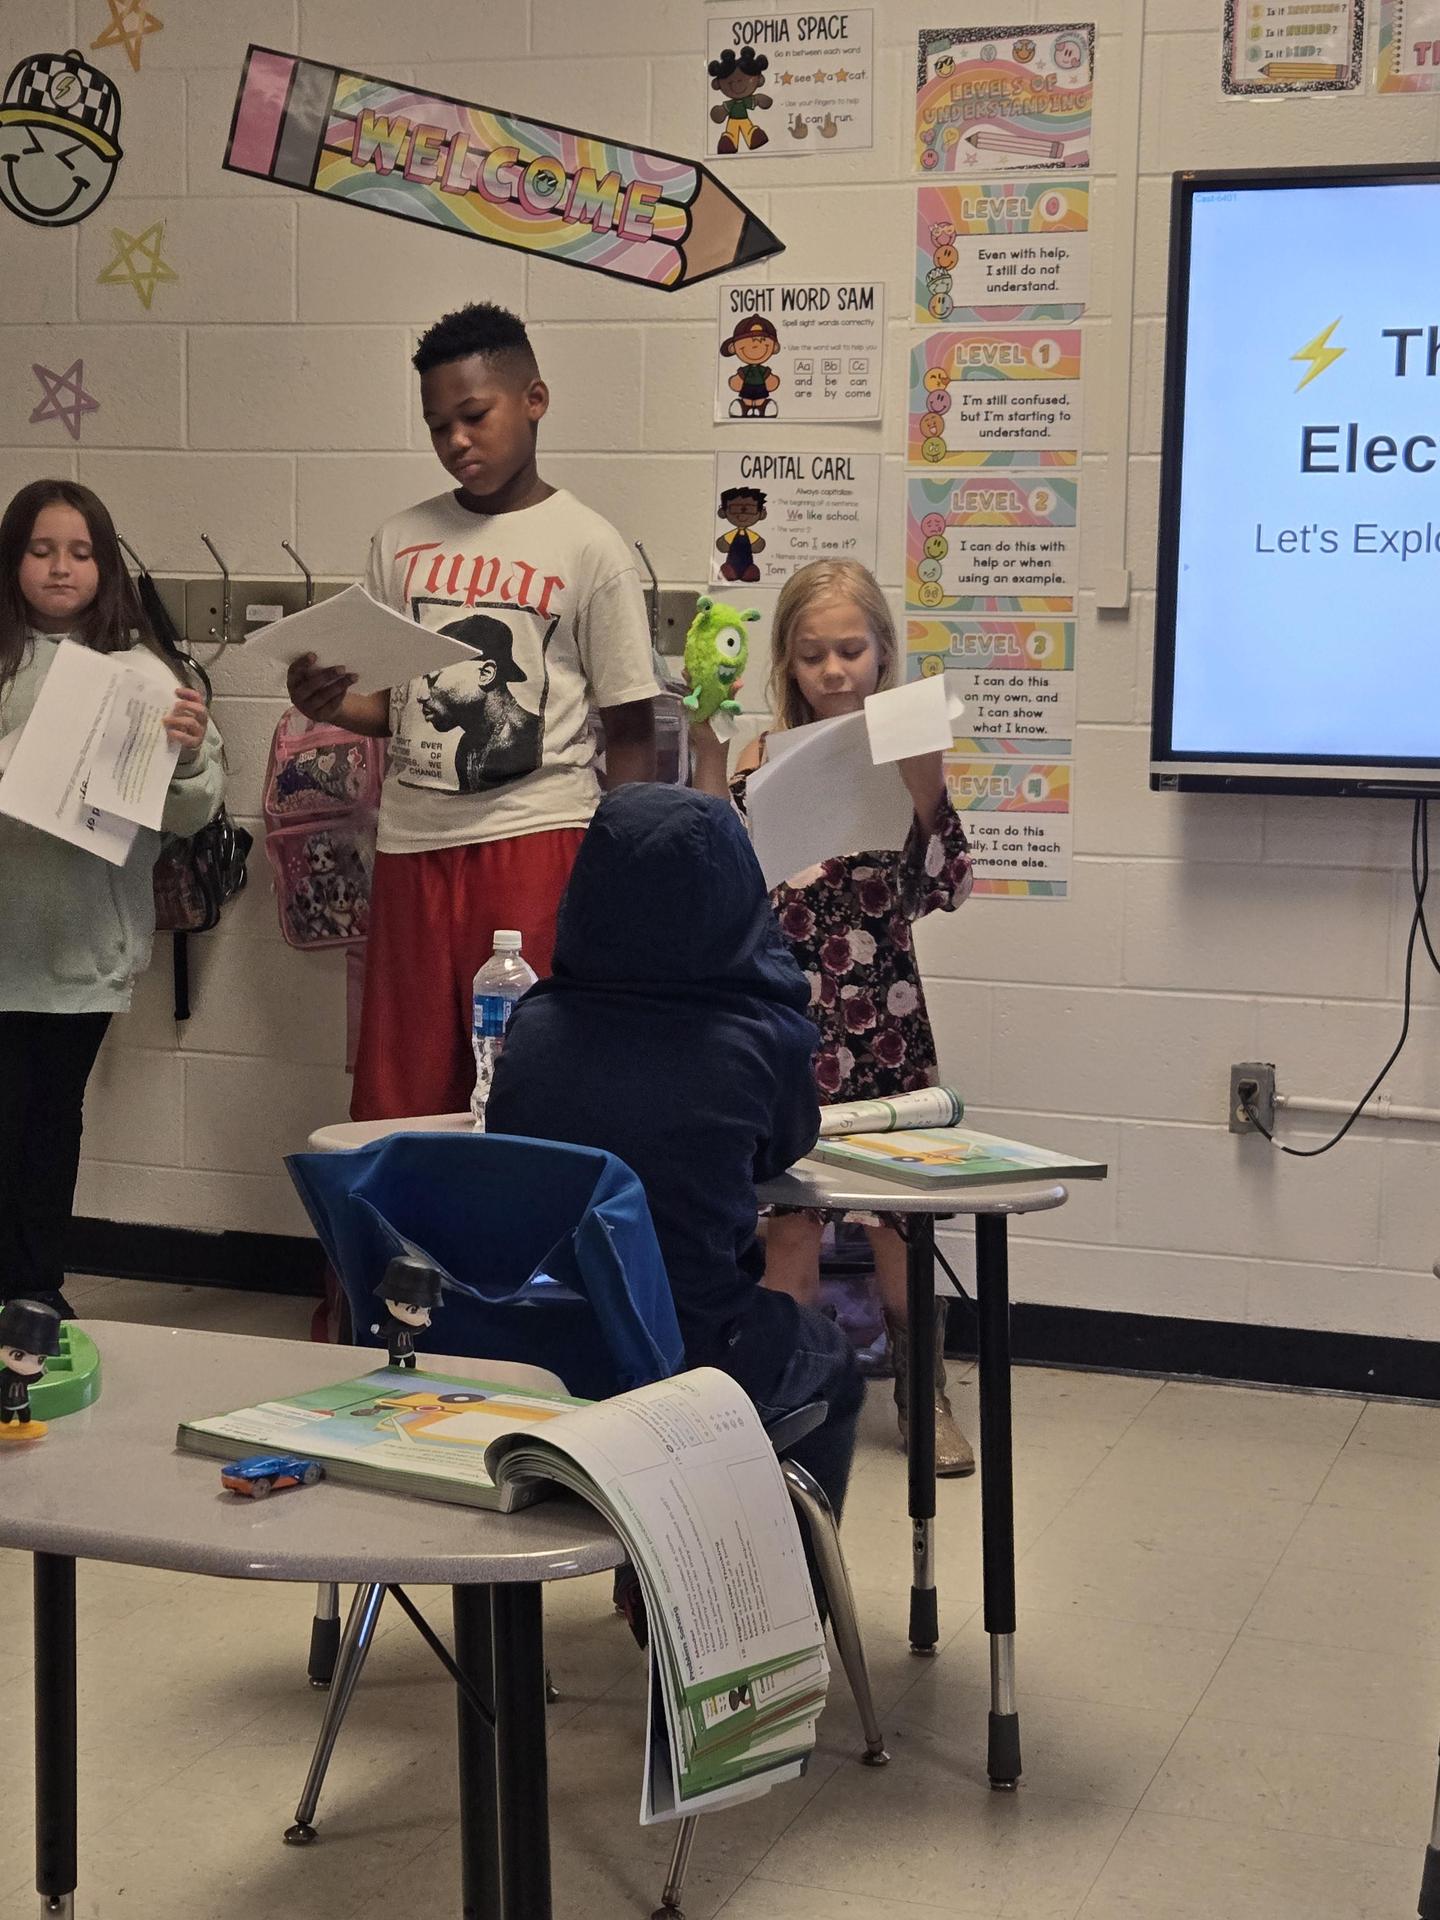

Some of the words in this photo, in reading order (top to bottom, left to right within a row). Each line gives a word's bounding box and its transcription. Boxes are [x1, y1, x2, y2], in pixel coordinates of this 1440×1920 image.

[732, 18, 789, 46] SOPHIA
[797, 15, 848, 41] SPACE
[792, 49, 822, 57] between
[774, 73, 780, 84] I
[794, 74, 811, 83] see
[826, 73, 833, 81] a
[951, 78, 1024, 102] LEVELS
[1031, 73, 1057, 92] OF
[922, 93, 1087, 124] UNDERSTANDING
[788, 114, 794, 124] I
[805, 115, 823, 124] can
[352, 109, 663, 243] WELCOME
[961, 197, 1033, 220] LEVEL
[1045, 197, 1059, 216] 0
[978, 249, 1006, 260] Even
[1010, 248, 1036, 259] with
[1040, 247, 1070, 260] help,
[986, 265, 992, 276] I
[996, 265, 1017, 275] still
[1021, 265, 1036, 275] do
[1040, 265, 1060, 274] not
[987, 280, 1059, 292] understand.
[730, 288, 775, 313] SIGHT
[781, 287, 830, 311] WORD
[837, 286, 874, 311] SAM
[782, 319, 798, 327] Spell
[799, 319, 815, 327] sight
[955, 343, 1025, 367] LEVEL
[1039, 344, 1050, 364] 1
[796, 361, 811, 371] Aa
[823, 361, 838, 371] Bb
[852, 361, 865, 371] Cc
[794, 376, 813, 386] and
[825, 376, 837, 386] be
[850, 378, 867, 386] can
[794, 390, 812, 398] are
[824, 388, 837, 399] by
[845, 390, 871, 398] come
[962, 395, 982, 405] I'm
[986, 395, 1007, 405] still
[1010, 394, 1070, 406] confused,
[960, 411, 980, 421] but
[984, 411, 1004, 421] I'm
[1008, 411, 1055, 423] starting
[1059, 411, 1071, 421] to
[979, 427, 1051, 438] understand.
[740, 455, 805, 480] CAPITAL
[811, 456, 855, 481] CARL
[796, 488, 819, 496] Always
[952, 490, 1023, 512] LEVEL
[1034, 491, 1049, 512] 2
[787, 510, 803, 521] We
[806, 510, 822, 520] like
[826, 510, 860, 521] school.
[790, 537, 808, 548] Can
[812, 537, 818, 550] I
[821, 541, 839, 549] see
[842, 538, 856, 549] it?
[1255, 523, 1339, 554] Let's
[960, 541, 966, 551] I
[970, 543, 991, 551] can
[995, 541, 1011, 551] do
[1014, 541, 1036, 551] this
[1039, 541, 1065, 551] with
[973, 557, 999, 569] help
[1020, 558, 1051, 567] when
[765, 563, 786, 576] Tom
[958, 575, 989, 585] using
[993, 575, 1008, 583] an
[1012, 574, 1066, 586] example.
[951, 634, 1021, 655] LEVEL
[973, 675, 980, 686] I
[983, 678, 1005, 686] can
[1009, 677, 1024, 687] do
[1028, 677, 1049, 687] this
[964, 693, 979, 702] on
[982, 694, 1000, 704] my
[1004, 694, 1032, 703] own,
[1035, 692, 1059, 703] and
[978, 707, 984, 717] I
[987, 709, 1009, 717] can
[1013, 707, 1043, 718] show
[973, 724, 1002, 733] what
[1006, 723, 1012, 733] I
[1015, 724, 1048, 734] know.
[421, 741, 442, 750] EVER
[948, 776, 1016, 797] LEVEL
[1028, 778, 1042, 797] 4
[969, 824, 975, 835] I
[979, 827, 1000, 835] can
[1004, 826, 1019, 836] do
[1023, 826, 1045, 836] this
[967, 840, 989, 851] sily.
[992, 841, 998, 850] I
[1002, 843, 1023, 851] can
[1027, 842, 1061, 853] teach
[971, 858, 1018, 867] omeone
[1021, 858, 1048, 868] else.
[713, 1540, 729, 1580] Thinking
[725, 1582, 736, 1609] Order
[671, 1605, 686, 1641] Solving
[732, 1611, 744, 1643] Higher
[682, 1641, 695, 1681] Problem
